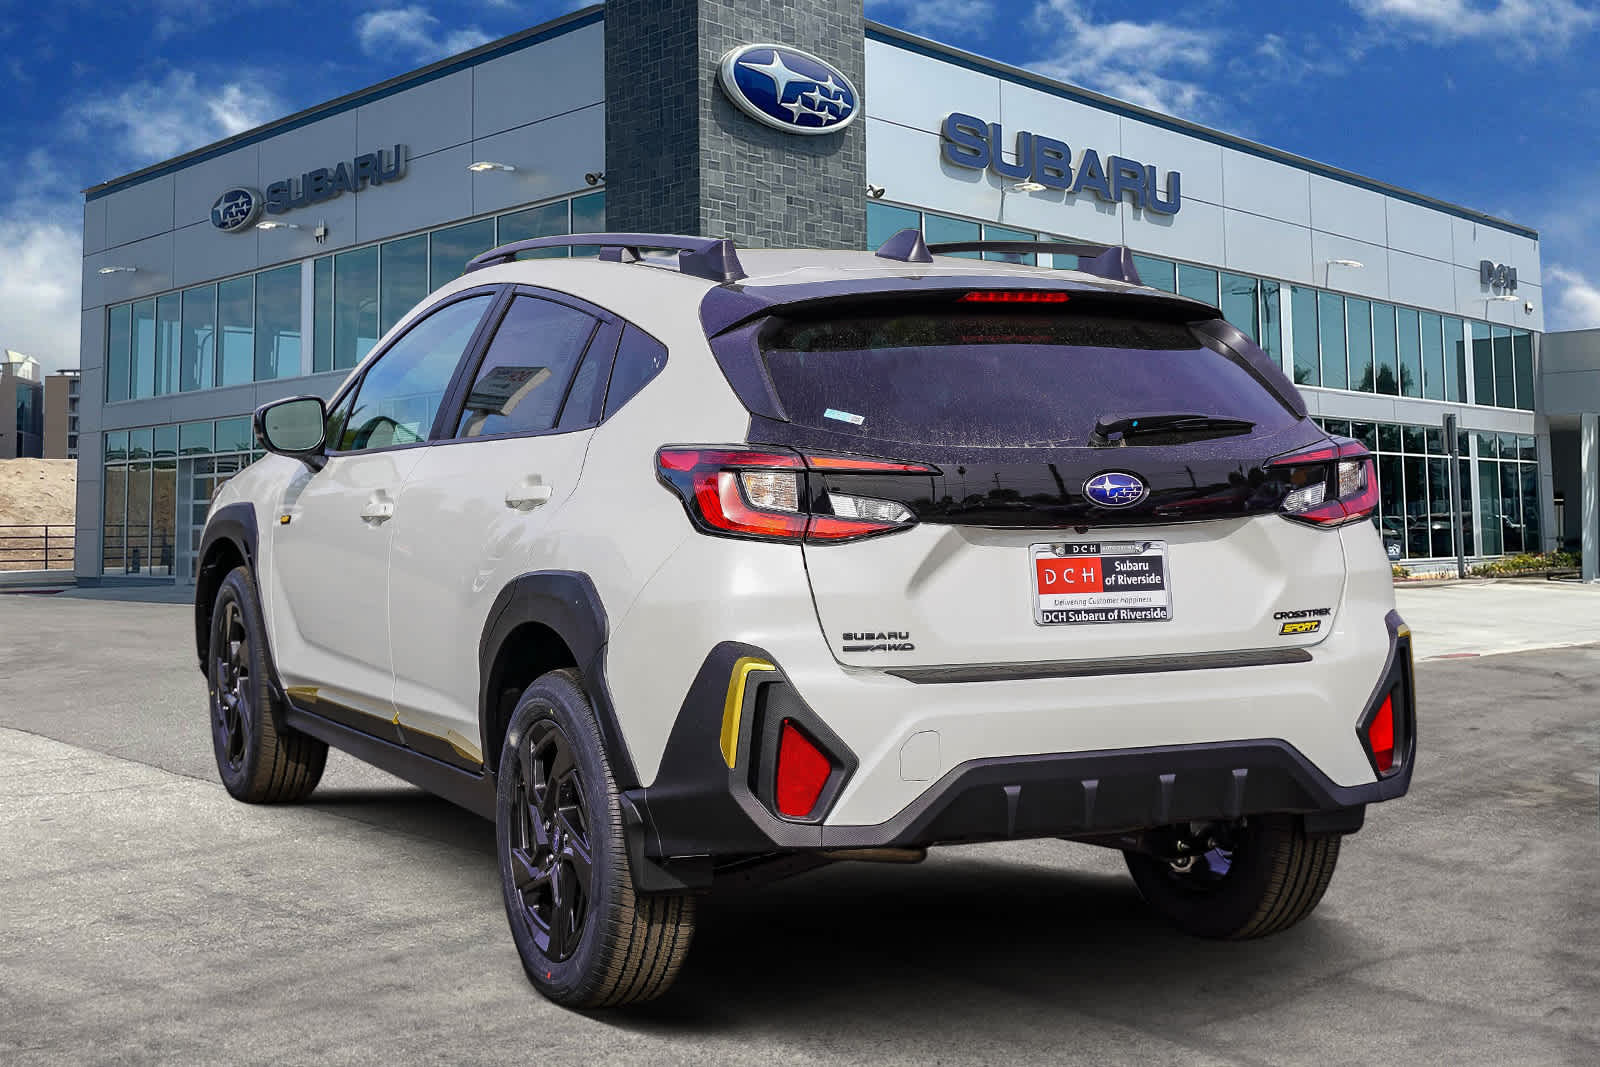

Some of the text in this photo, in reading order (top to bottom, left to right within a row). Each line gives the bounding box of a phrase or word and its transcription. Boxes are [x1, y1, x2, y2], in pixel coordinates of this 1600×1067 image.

[941, 112, 1181, 215] SUBARU
[266, 144, 407, 214] SUBARU
[1114, 561, 1149, 571] Subaru
[1105, 572, 1161, 586] of Riverside
[1054, 598, 1087, 606] Delivering
[1043, 607, 1167, 622] DCH Subaru of Riverside
[1273, 607, 1331, 620] CROSSTREK
[1283, 621, 1318, 633] SPORT
[842, 631, 910, 641] SUBARU
